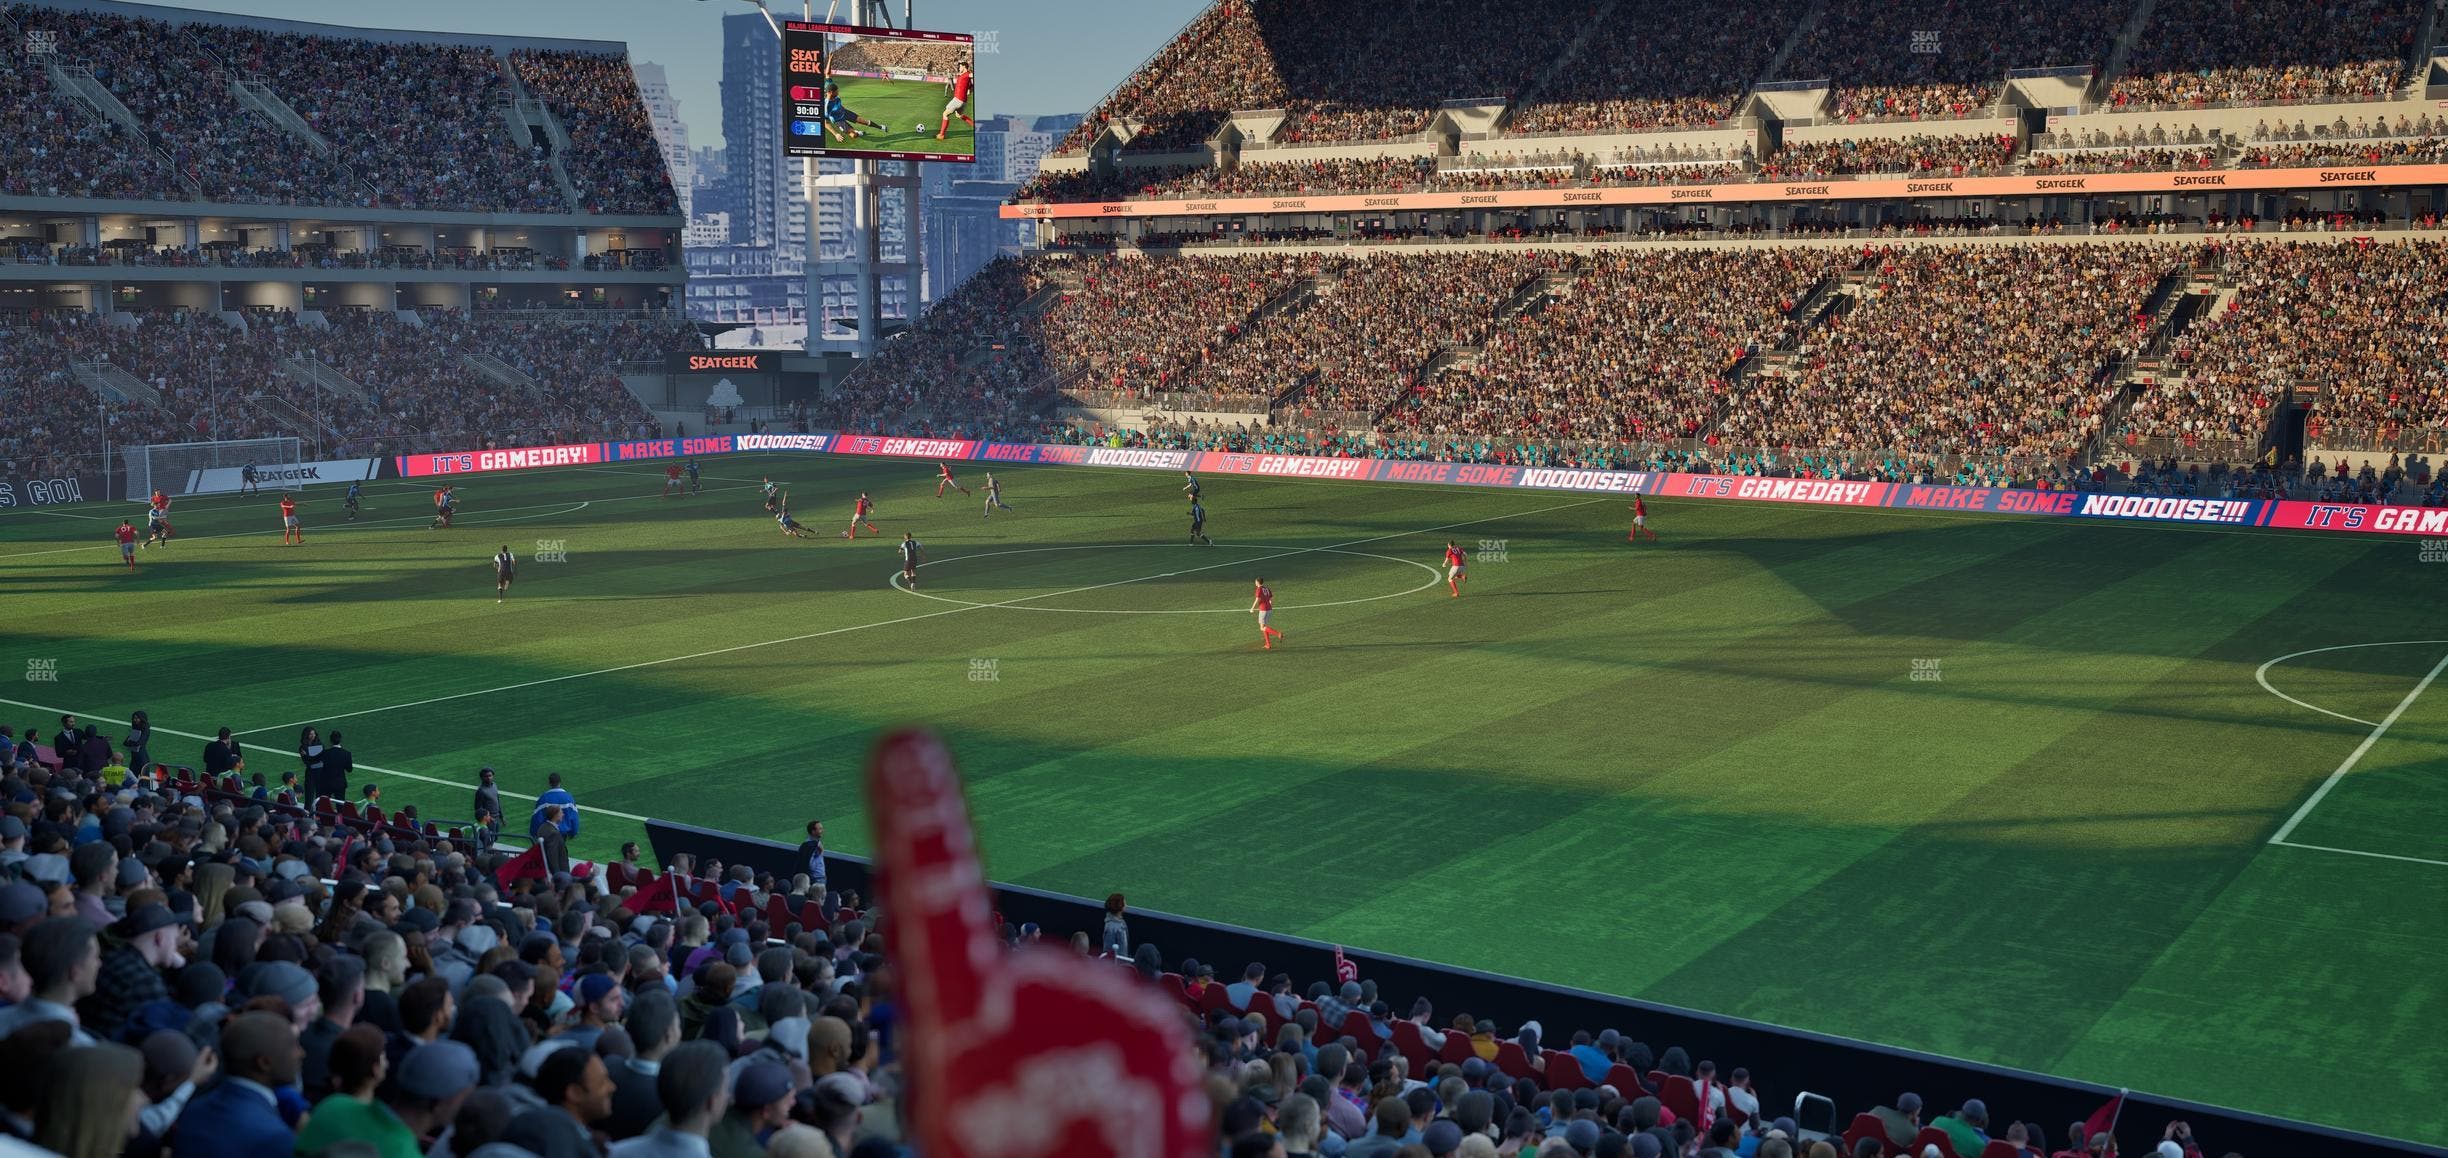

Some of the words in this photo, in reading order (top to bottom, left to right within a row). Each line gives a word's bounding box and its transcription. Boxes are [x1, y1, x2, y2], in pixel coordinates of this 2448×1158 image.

[791, 48, 820, 62] SEAT
[790, 61, 822, 74] GEEK
[796, 106, 820, 115] 90:00
[810, 125, 816, 133] 2
[2173, 175, 2226, 186] SEATGEEK
[2320, 171, 2376, 182] SEATGEEK
[1907, 183, 1953, 192] SEATGEEK
[2036, 179, 2086, 189] SEATGEEK
[1563, 192, 1602, 201] SEATGEEK
[1671, 189, 1713, 199] SEATGEEK
[1785, 186, 1829, 196] SEATGEEK
[1272, 200, 1306, 209] SEATGEEK
[1364, 198, 1400, 207] SEATGEEK
[1460, 195, 1498, 204] SEATGEEK
[1023, 207, 1053, 216] SEATGEEK
[1102, 205, 1133, 214] SEATGEEK
[1185, 202, 1217, 211] SEATGEEK
[690, 355, 759, 370] SEATGEEK
[619, 440, 675, 460] MAKE
[682, 436, 732, 456] SOME
[736, 434, 828, 451] NOOOOISE!!!
[850, 438, 881, 453] IT'S
[881, 439, 965, 458] GAMEDAY!
[433, 455, 473, 473] IT'S
[480, 447, 588, 471] GAMEDAY!
[984, 444, 1036, 461] MAKE
[1039, 446, 1087, 463] SOME
[1088, 448, 1188, 469] NOOOOISE!!!
[1217, 454, 1256, 472] IT'S
[1258, 456, 1360, 477] GAMEDAY!
[1386, 462, 1451, 481] MAKE
[1456, 465, 1518, 485] SOME
[1519, 468, 1646, 492] NOOOOISE!!!
[26, 477, 84, 505] GO!
[1687, 476, 1734, 497] IT'S
[1738, 479, 1870, 503] GAMEDAY!
[1906, 486, 1990, 509] MAKE
[1997, 490, 2078, 513] SOME
[2080, 494, 2250, 522] NOOOOISE!!!
[2304, 504, 2368, 529] IT'S
[2373, 508, 2448, 534] GAM
